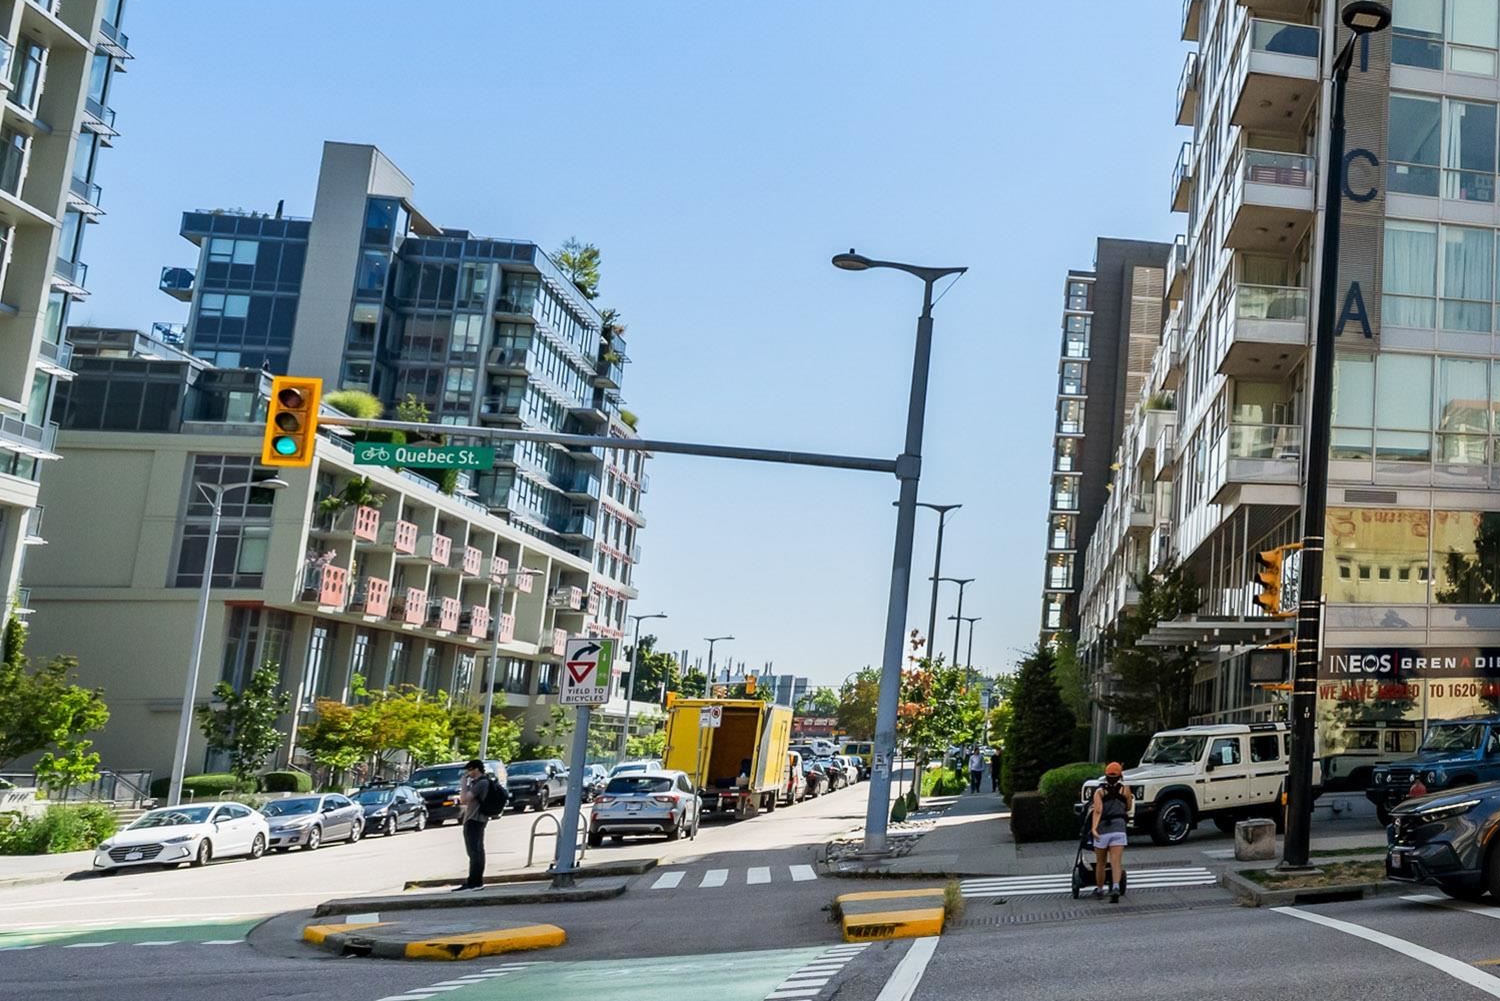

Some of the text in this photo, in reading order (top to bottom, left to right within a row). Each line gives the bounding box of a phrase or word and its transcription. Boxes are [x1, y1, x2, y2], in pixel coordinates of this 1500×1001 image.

[395, 447, 480, 465] Quebec St.
[1329, 654, 1392, 673] INEOS
[567, 687, 590, 695] YIELD
[1319, 685, 1337, 700] WE
[1429, 683, 1444, 698] TO
[1448, 683, 1477, 697] 1620
